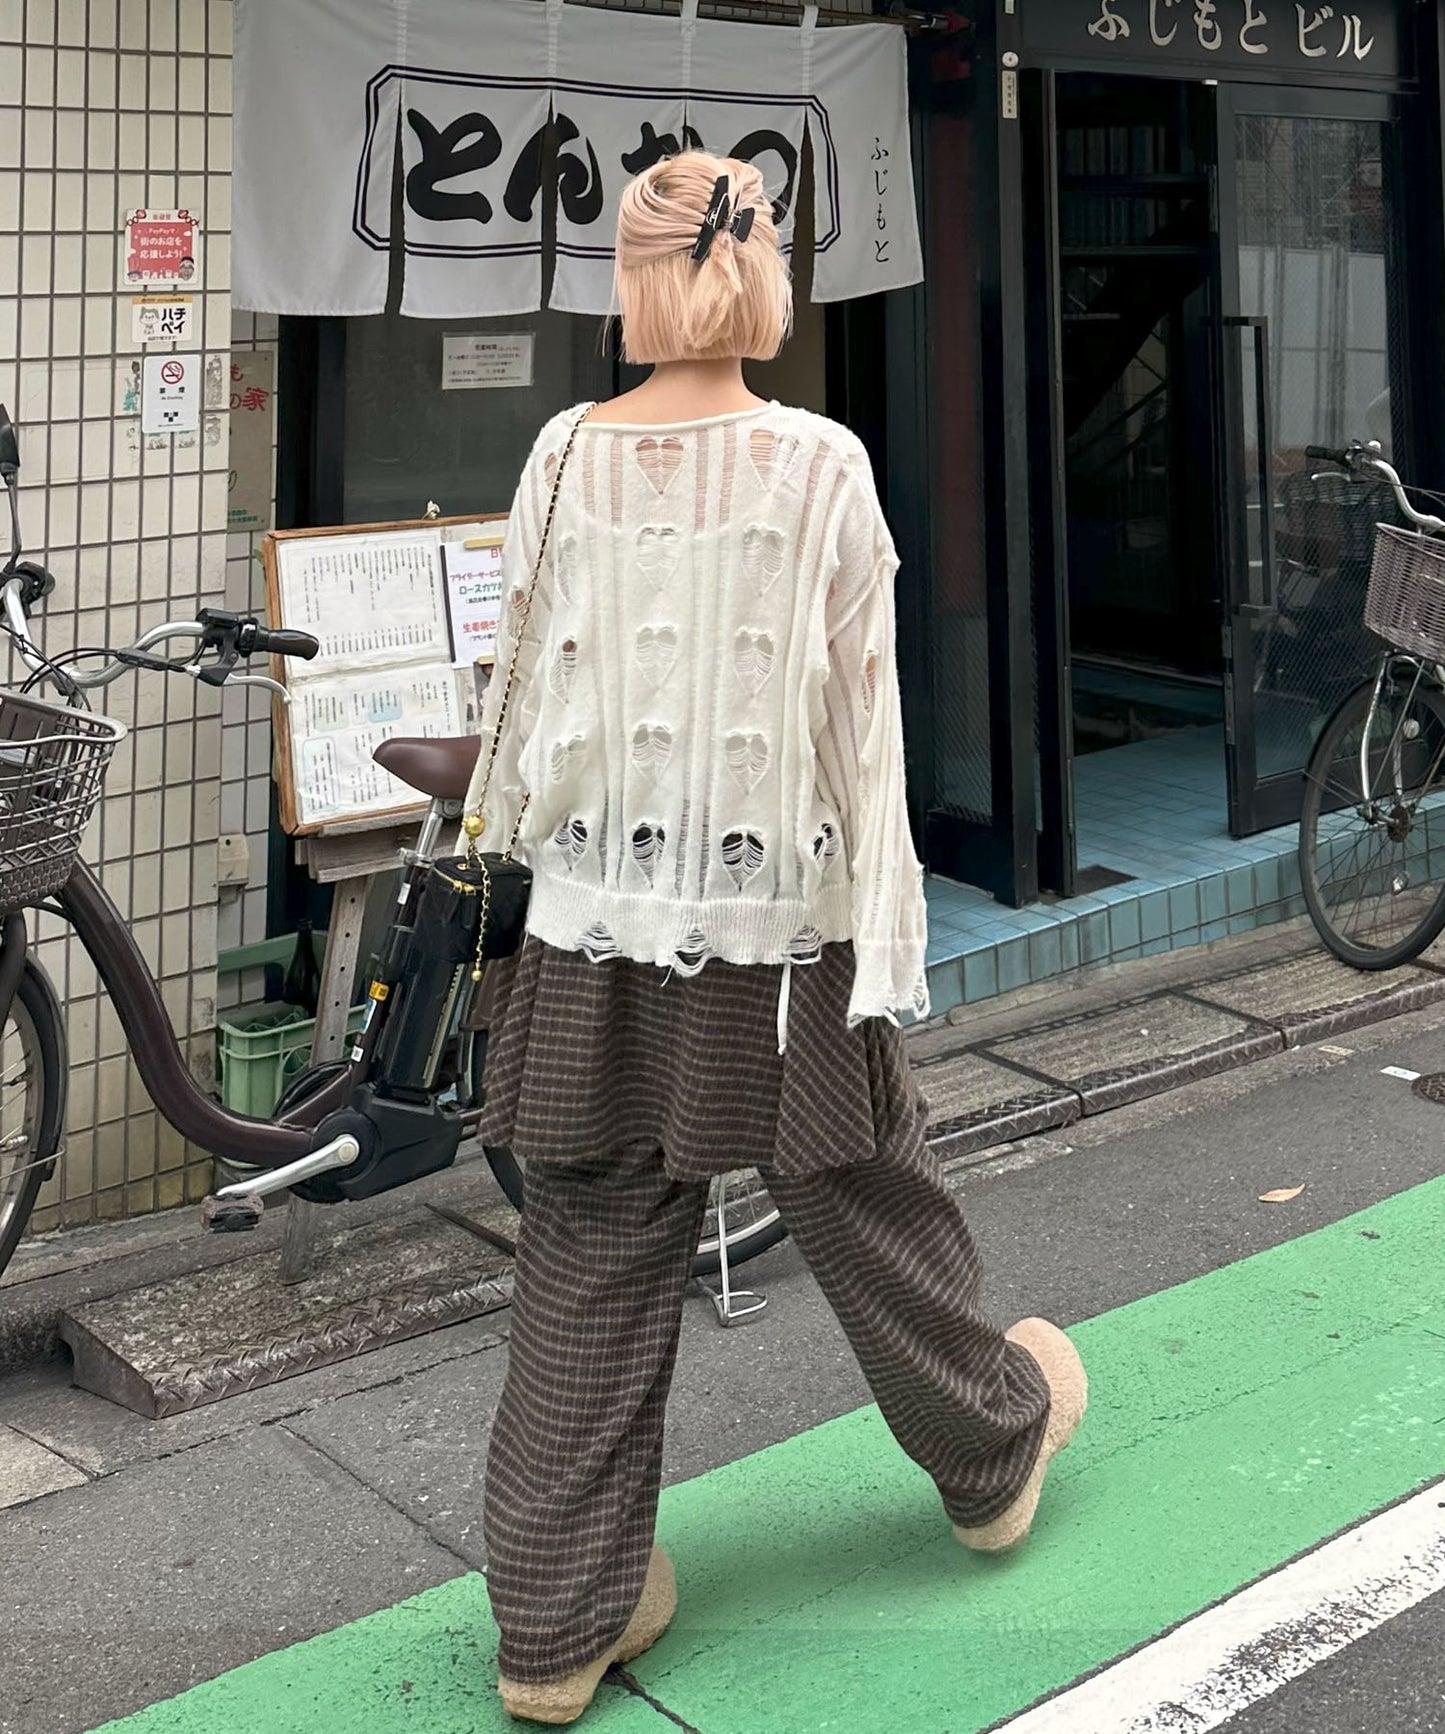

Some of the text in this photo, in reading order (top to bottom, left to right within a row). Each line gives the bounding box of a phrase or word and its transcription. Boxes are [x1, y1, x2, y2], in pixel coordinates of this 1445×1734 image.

[870, 136, 889, 263] ふじもと
[161, 307, 186, 321] ハチ
